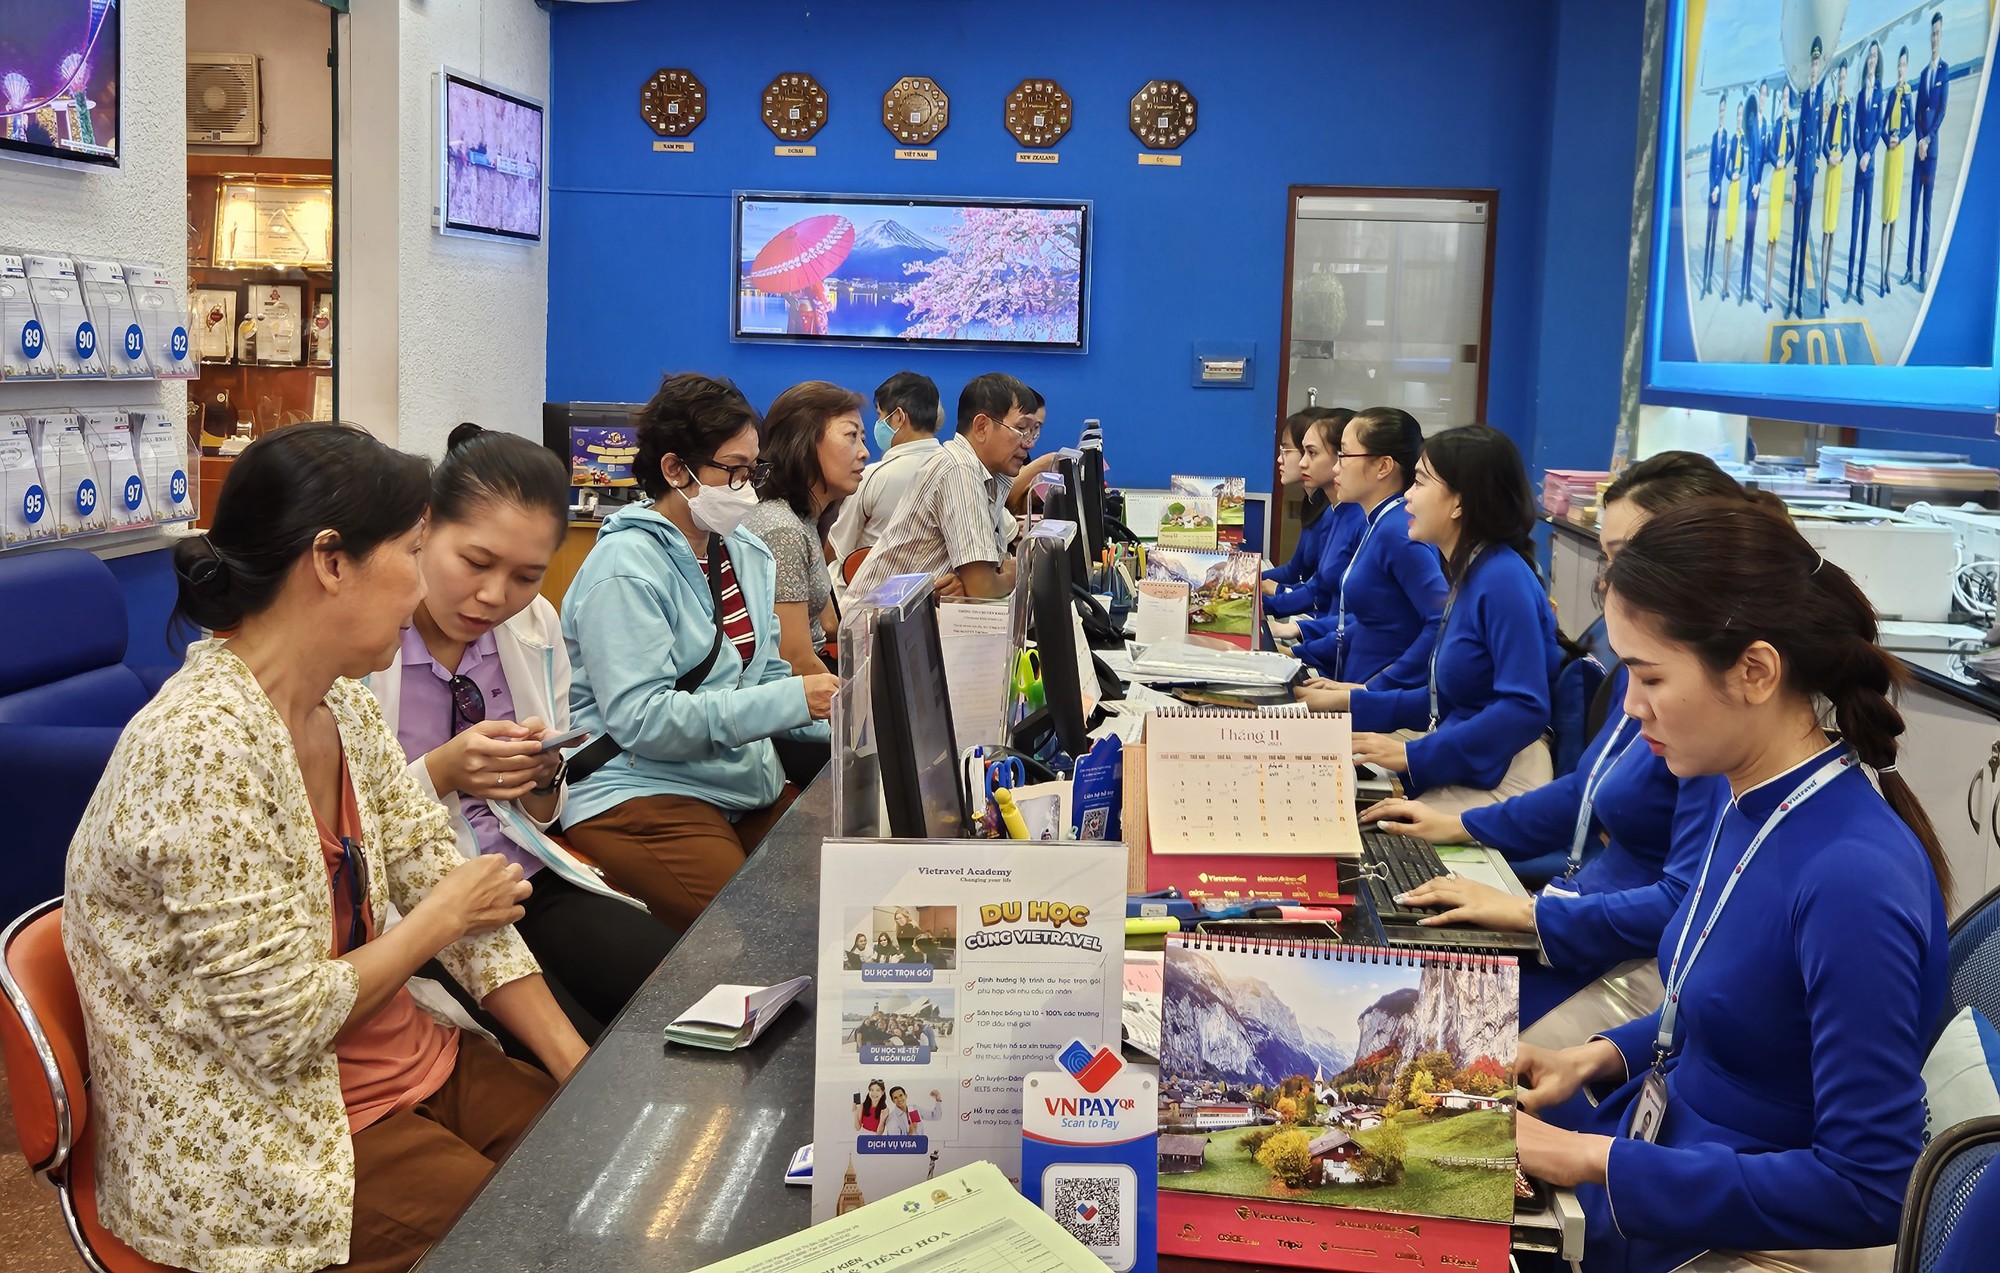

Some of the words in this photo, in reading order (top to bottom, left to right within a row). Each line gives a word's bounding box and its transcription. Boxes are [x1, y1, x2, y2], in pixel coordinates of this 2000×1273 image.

[25, 329, 40, 347] 89
[79, 329, 93, 348] 90
[128, 333, 141, 350] 91
[174, 335, 186, 352] 92
[128, 484, 140, 501] 97
[173, 478, 185, 495] 98
[27, 494, 41, 512] 95
[80, 488, 94, 506] 96
[1270, 730, 1279, 740] 11
[918, 867, 964, 876] Vietravel
[967, 867, 1012, 877] Academy
[980, 901, 1022, 927] DU
[1028, 901, 1090, 928] HỌC
[965, 931, 1013, 950] CÙNG
[1013, 930, 1102, 952] VIETRAVEL
[877, 969, 893, 978] HỌC
[895, 969, 915, 978] TRỌN
[917, 968, 931, 977] GÓI
[1061, 1118, 1085, 1128] Scan
[1088, 1118, 1098, 1128] to
[1101, 1118, 1120, 1131] Pay
[867, 1140, 886, 1149] DỊCH
[888, 1141, 899, 1150] VỤ
[900, 1140, 917, 1148] VISA
[915, 1231, 951, 1249] HOA
